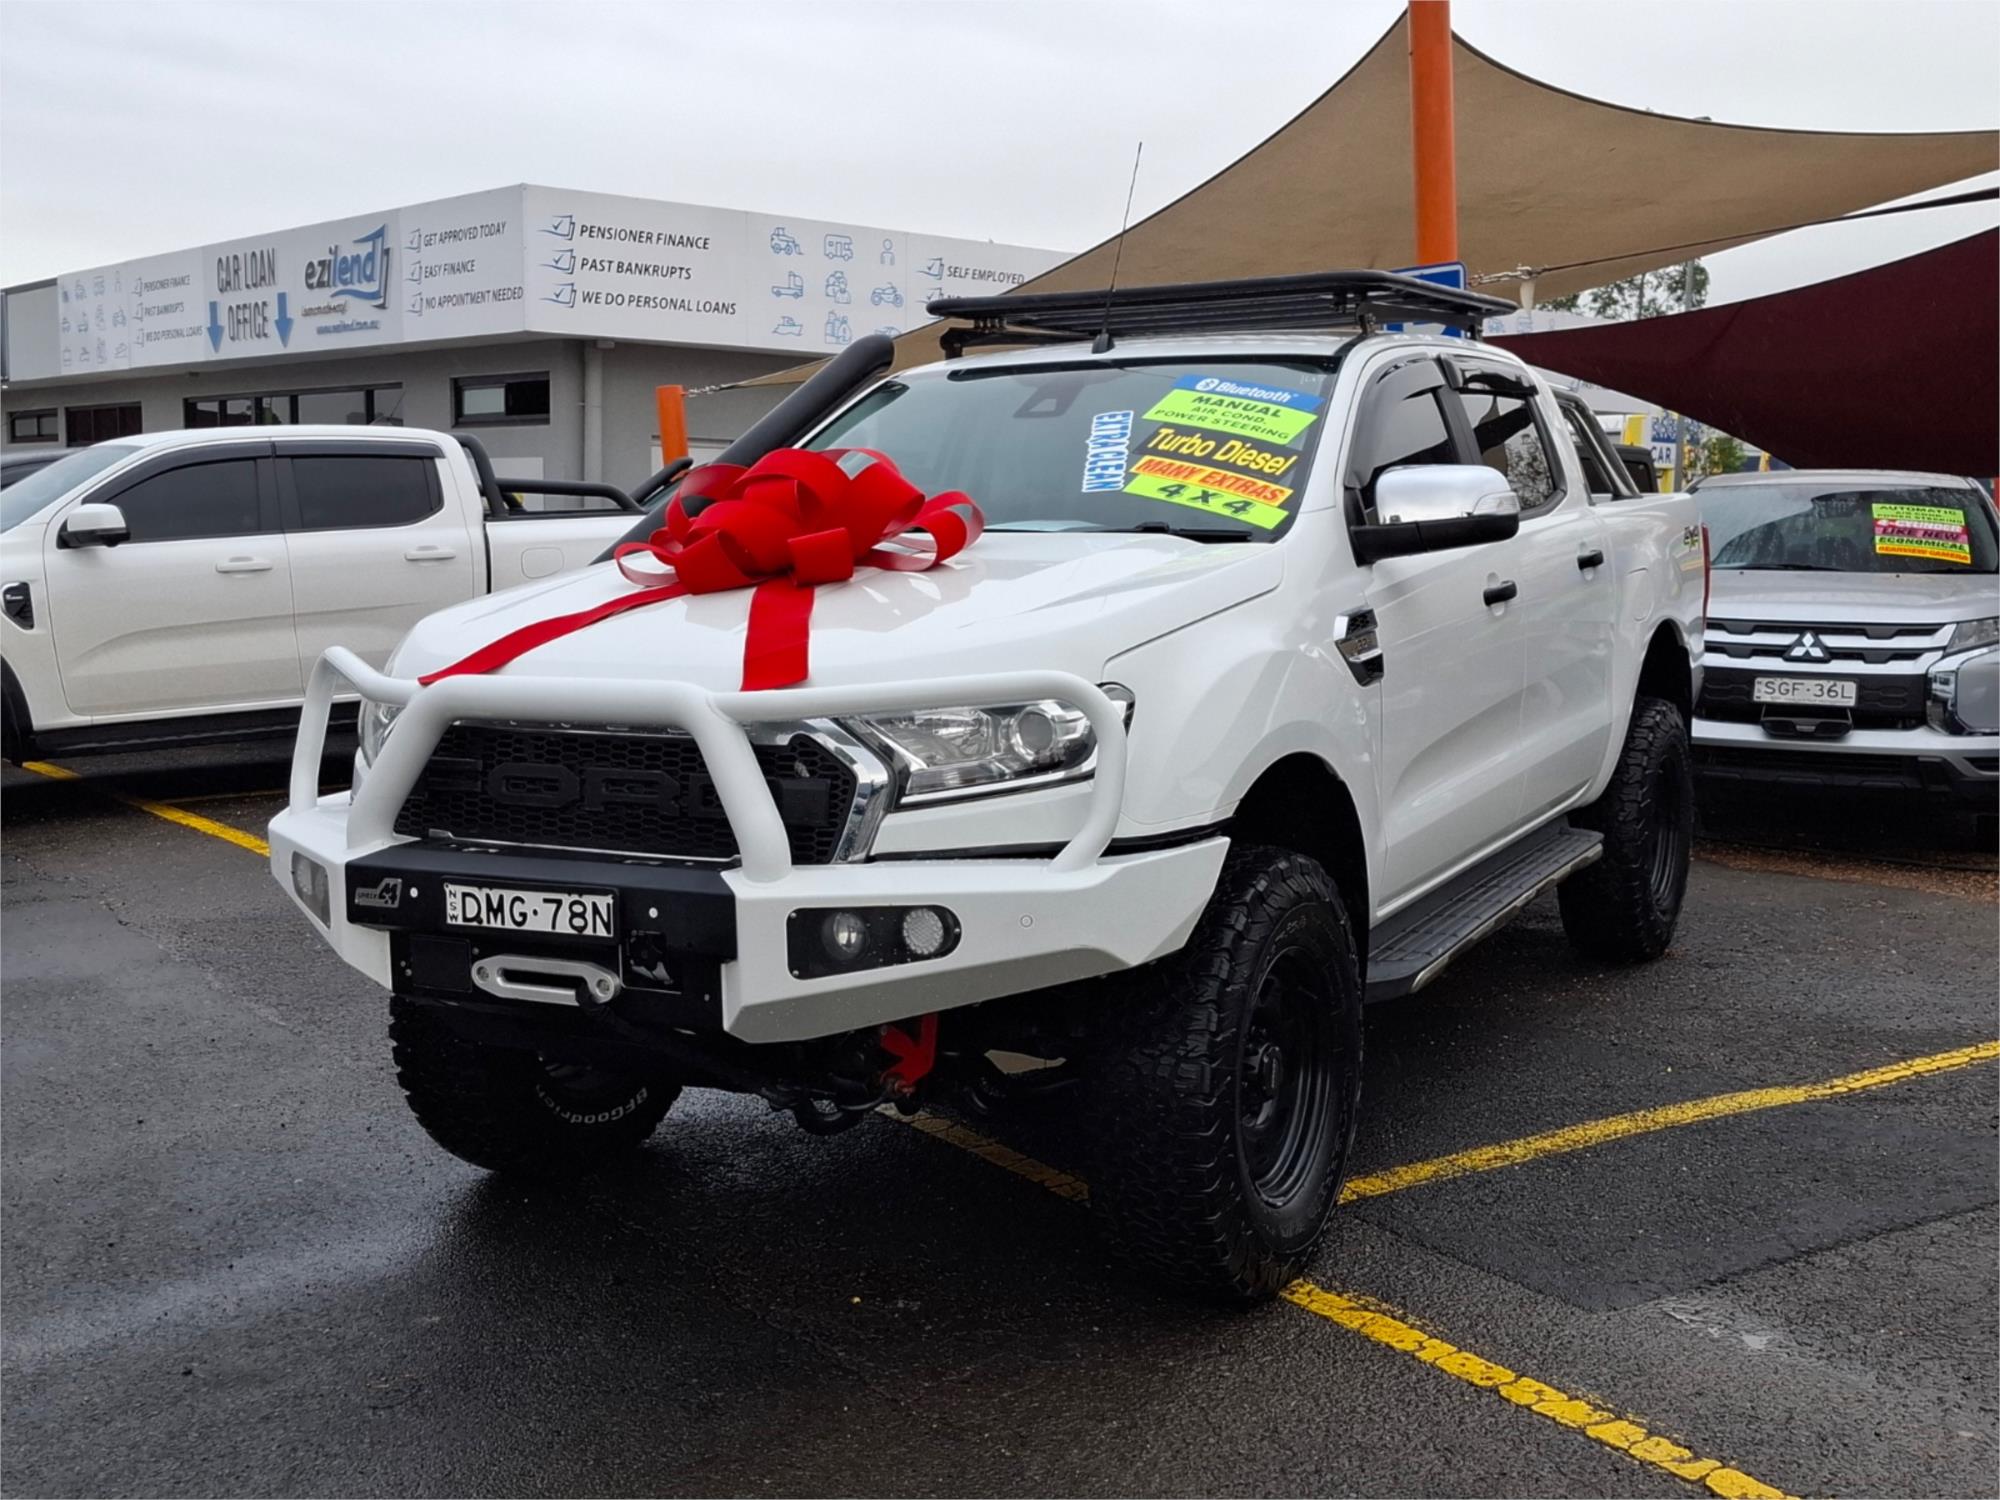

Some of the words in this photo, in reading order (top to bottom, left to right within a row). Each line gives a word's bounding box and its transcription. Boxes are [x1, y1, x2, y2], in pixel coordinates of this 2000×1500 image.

[423, 233, 438, 247] GET
[439, 226, 478, 245] APPROVED
[480, 221, 506, 239] TODAY
[580, 224, 653, 244] PENSIONER
[656, 232, 710, 250] FINANCE
[217, 254, 242, 294] CAR
[244, 248, 276, 290] LOAN
[305, 243, 377, 289] ezilend
[424, 264, 442, 279] EASY
[443, 259, 475, 276] FINANCE
[581, 257, 614, 272] PAST
[616, 261, 691, 280] BANKRUPTS
[947, 266, 970, 279] SELF
[971, 268, 1025, 285] EMPLOYED
[425, 297, 436, 309] NO
[437, 289, 491, 308] APPOINTMENT
[492, 286, 524, 302] NEEDED
[582, 290, 602, 304] WE
[605, 292, 625, 306] DO
[628, 294, 693, 312] PERSONAL
[696, 300, 737, 315] LOANS
[228, 301, 269, 342] OFFICE
[1215, 381, 1292, 403] Bluetooth
[1191, 406, 1218, 416] AIR
[1221, 411, 1266, 425] COND.
[1192, 395, 1282, 418] MANUAL
[1154, 409, 1207, 422] POWER
[1211, 418, 1289, 440] STEERING
[1147, 427, 1216, 457] Turbo
[1212, 440, 1298, 475] Diesel
[1135, 458, 1203, 480] MANY
[1198, 471, 1285, 501] EXTRAS
[1880, 506, 1957, 516] AUTOMATIC
[1879, 536, 1965, 550] ECONOMICAL
[1881, 526, 1915, 537] LIKE
[1922, 529, 1960, 541] NEW
[448, 889, 459, 923] NSW
